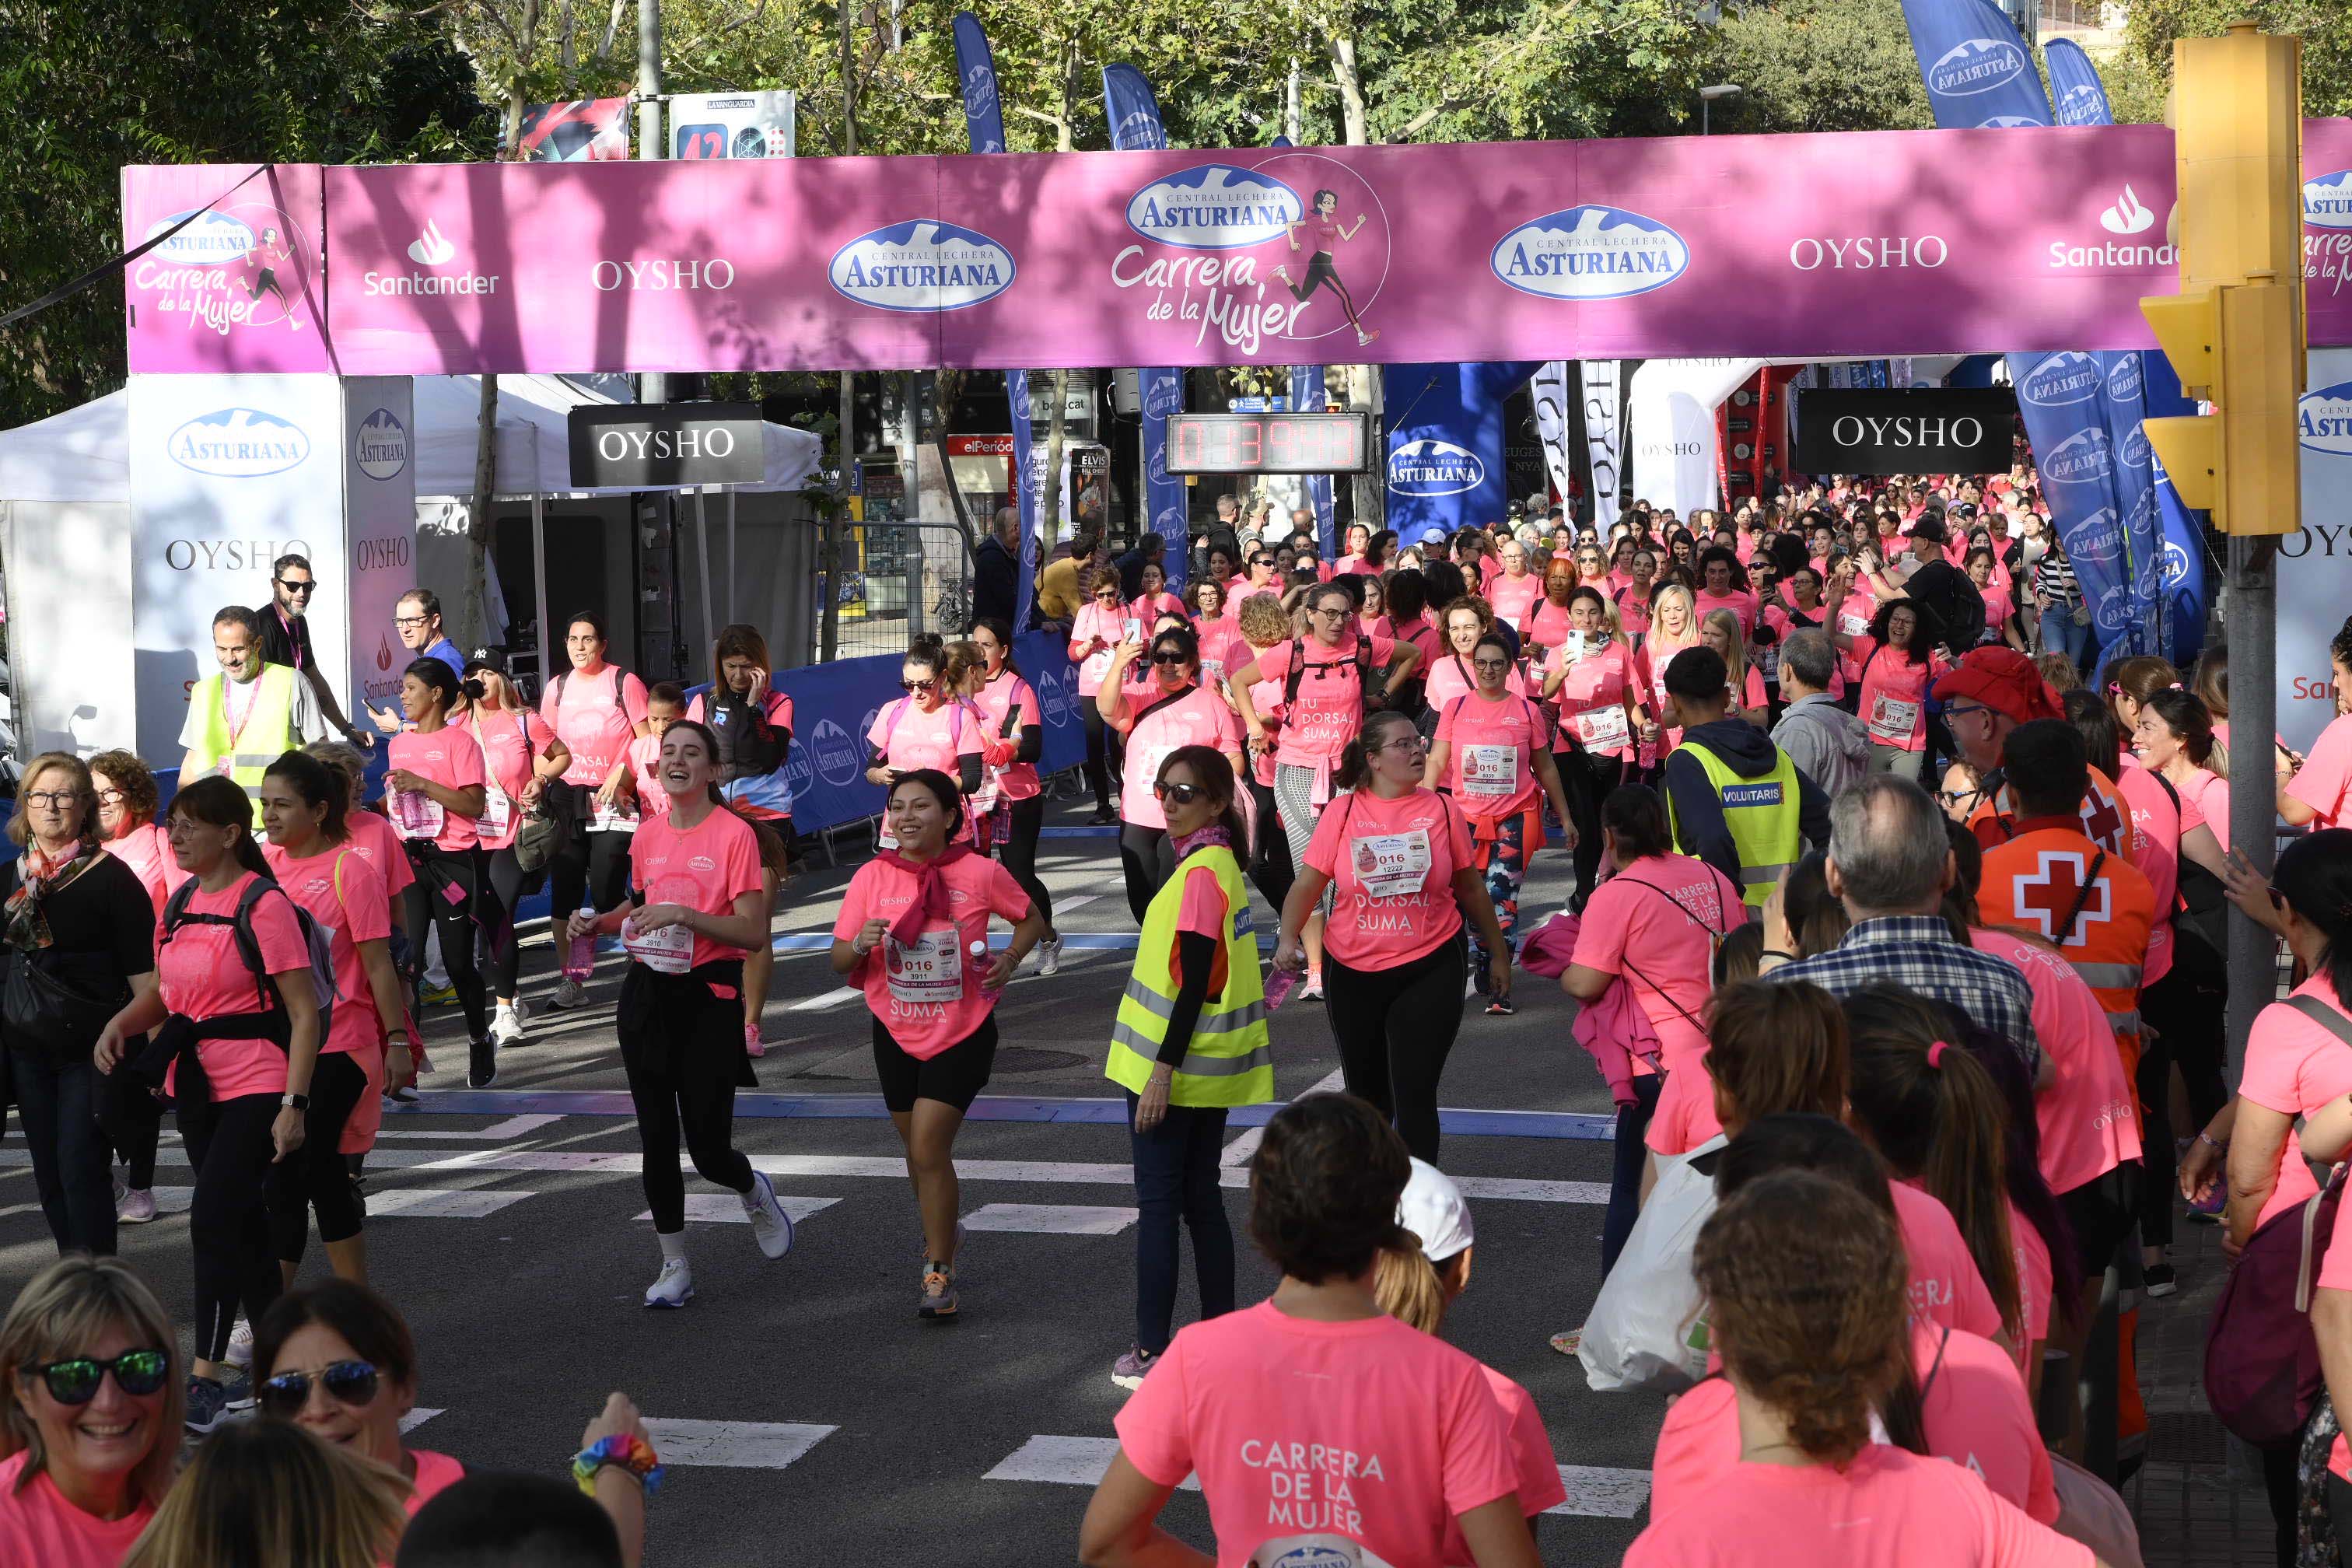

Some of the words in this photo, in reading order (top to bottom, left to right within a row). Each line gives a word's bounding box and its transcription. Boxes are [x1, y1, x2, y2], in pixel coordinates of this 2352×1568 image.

[716, 100, 754, 108] VANGUARDIA
[1167, 194, 1223, 202] CENTRAL
[1229, 193, 1284, 201] LECHERA
[1139, 196, 1288, 228] ASTURIANA
[1537, 238, 1595, 248] CENTRAL
[1603, 236, 1668, 246] LECHERA
[872, 251, 931, 261] CENTRAL
[936, 250, 995, 259] LECHERA
[1507, 241, 1674, 278] ASTURIANA
[1790, 236, 1948, 270] OYSHO
[2049, 241, 2180, 268] Santand
[135, 261, 226, 290] Carrera
[843, 254, 1001, 289] ASTURIANA
[1111, 244, 1255, 289] Carrera
[2322, 257, 2336, 278] la
[364, 272, 499, 296] Santander
[592, 260, 734, 292] OYSHO
[158, 294, 175, 311] de
[179, 291, 191, 311] la
[190, 289, 261, 336] Mujer
[1147, 290, 1174, 320] de
[1180, 288, 1199, 320] la
[1197, 280, 1311, 355] Mujer
[1042, 401, 1084, 411] b.cat
[2319, 406, 2352, 415] CENT
[1833, 416, 1983, 447] OYSHO
[180, 433, 299, 460] ASTURIANA
[359, 433, 404, 464] ASTURIANA
[599, 428, 735, 461] OYSHO
[964, 439, 1013, 453] elPeriód
[1642, 442, 1701, 456] OYSHO
[1082, 455, 1106, 465] ELVIS
[1389, 463, 1477, 484] ASTURIANA
[2277, 524, 2352, 558] OYS
[357, 535, 409, 572] OYSHO
[364, 678, 404, 702] Santande
[1300, 698, 1318, 709] TU
[1577, 699, 1592, 709] TU
[1301, 712, 1354, 724] DORSAL
[1886, 714, 1902, 723] 016
[1303, 727, 1341, 740] SUMA
[1595, 723, 1612, 732] 016
[572, 753, 610, 767] ORSAL
[817, 746, 856, 772] ASTURIANA
[1723, 788, 1780, 803] VOLUNTARIS
[2130, 809, 2152, 822] RA
[2133, 824, 2143, 835] A
[2132, 836, 2149, 850] ER
[1379, 854, 1405, 864] 016
[1664, 880, 1718, 903] CARRERA
[880, 896, 912, 907] OYSHO
[1680, 898, 1699, 911] DE
[1699, 895, 1717, 908] LA
[1357, 914, 1412, 930] SUMA
[2014, 943, 2039, 962] CA
[660, 960, 684, 968] Santander
[905, 961, 933, 971] 016
[890, 999, 947, 1017] SUMA
[2093, 1105, 2132, 1130] OYHO
[1241, 1440, 1384, 1482] CARRERA
[1270, 1472, 1311, 1500] DE
[1325, 1473, 1356, 1507] LA
[1269, 1498, 1363, 1535] MUJER
